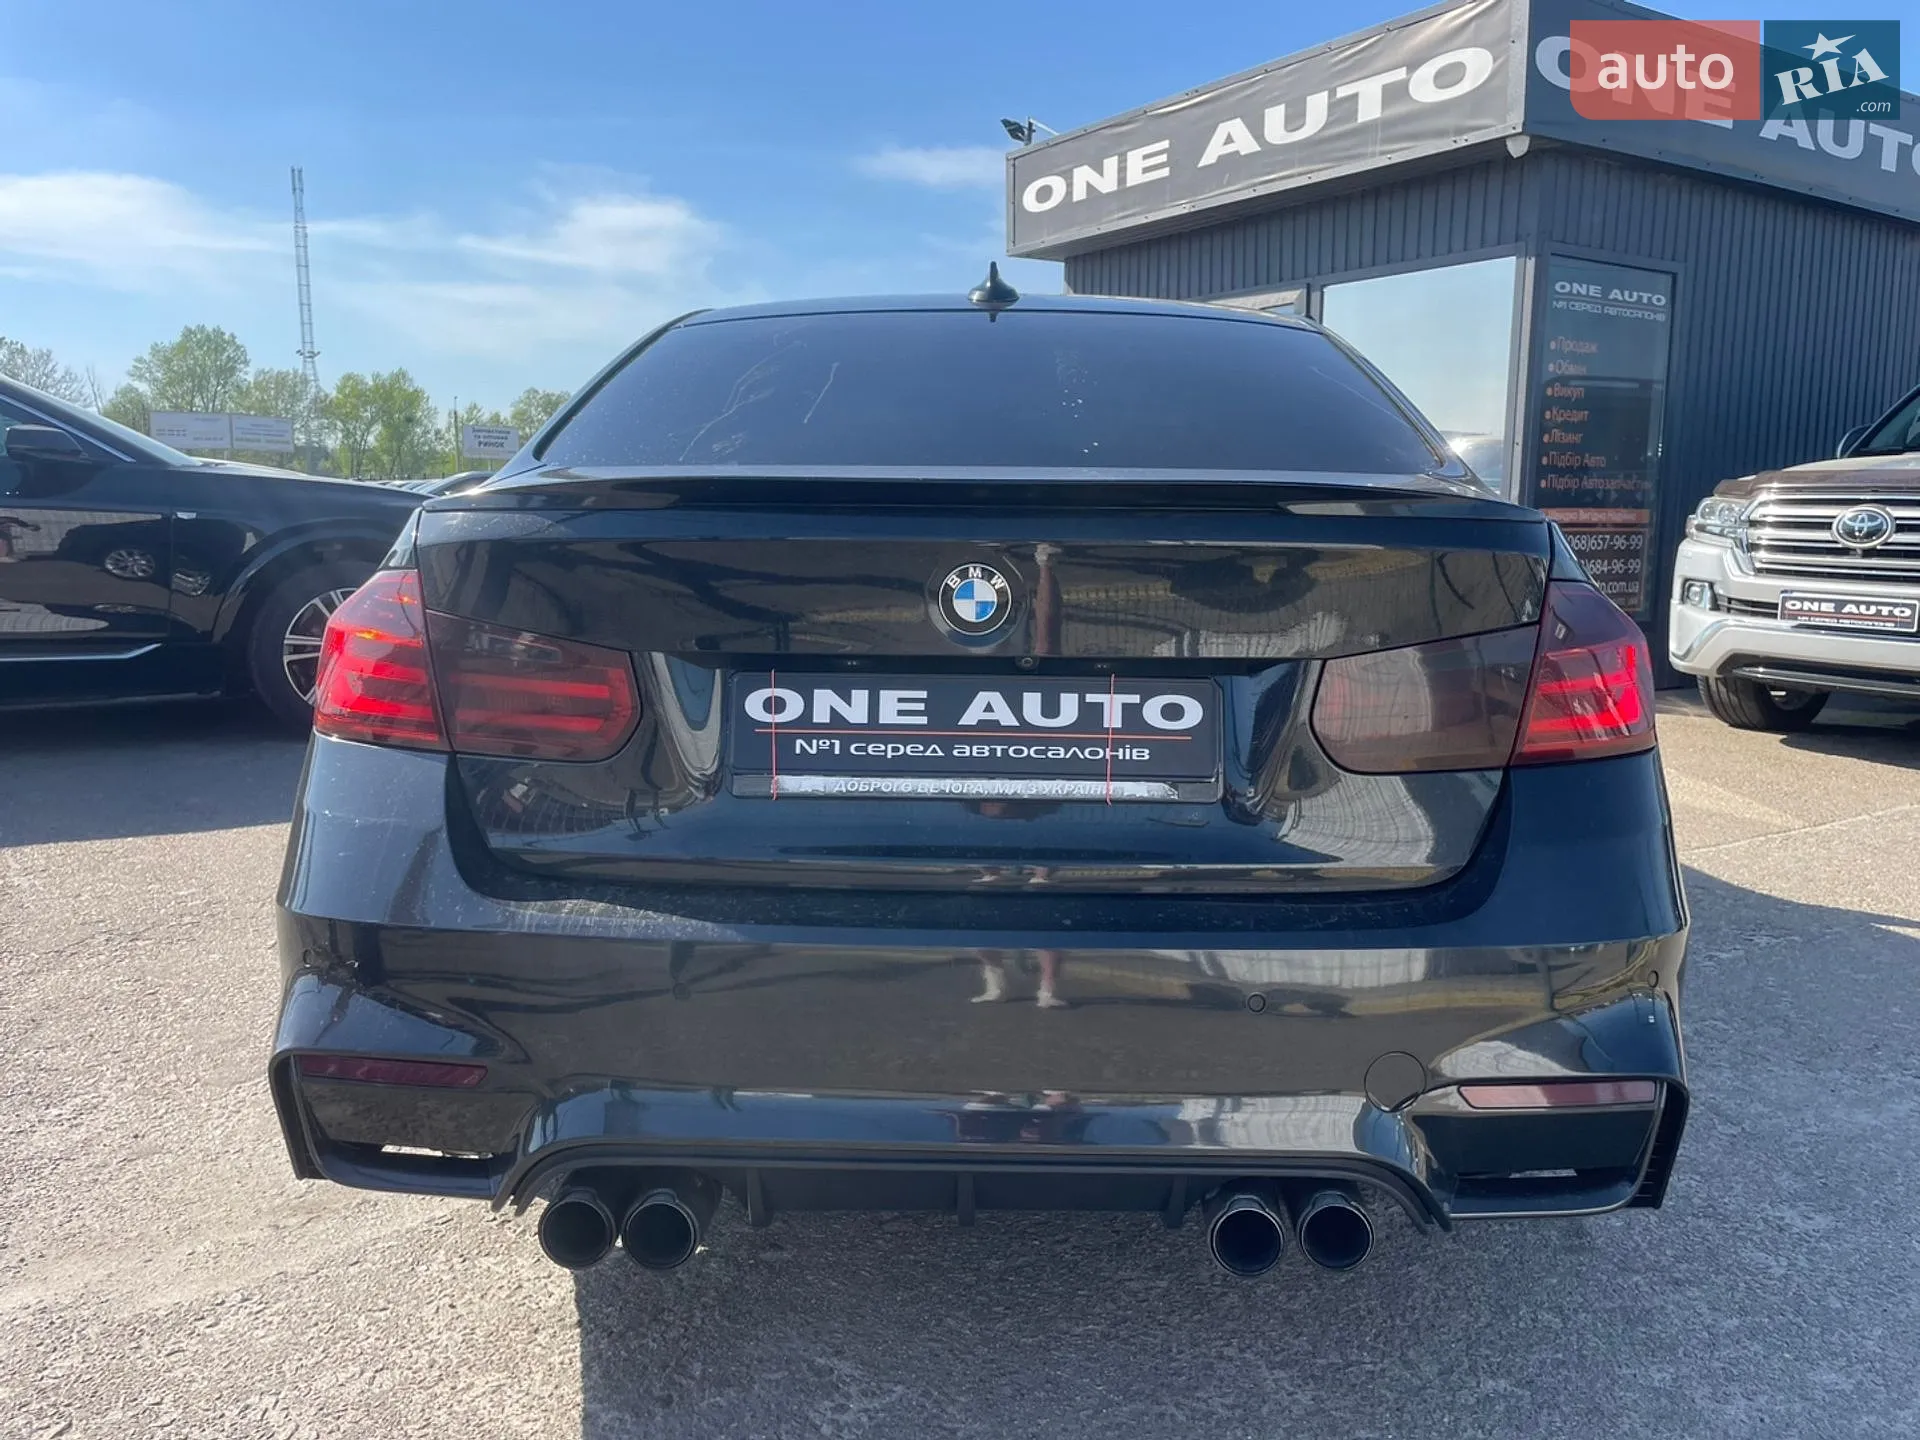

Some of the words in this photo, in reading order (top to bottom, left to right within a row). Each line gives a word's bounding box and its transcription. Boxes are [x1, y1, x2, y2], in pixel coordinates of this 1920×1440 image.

[1535, 36, 1736, 129] ONE
[1022, 140, 1170, 213] ONE
[1197, 47, 1494, 168] AUTO
[1554, 281, 1602, 298] ONE
[1608, 289, 1666, 306] AUTO
[1553, 382, 1585, 401] Викуп
[1552, 405, 1590, 424] Кредит
[1549, 428, 1583, 443] Лізинг
[1549, 452, 1581, 469] Підбір
[1583, 454, 1606, 468] Авто
[1547, 474, 1580, 491] Підбір
[946, 566, 1006, 590] BMW
[1785, 600, 1836, 612] ONE
[1841, 604, 1912, 617] AUTO
[744, 688, 928, 725] ONE
[957, 691, 1204, 731] AUTO
[795, 738, 840, 755] №1
[850, 742, 945, 759] серед
[952, 744, 1151, 760] автосалонів
[834, 780, 912, 794] ДОБРОГО
[995, 782, 1021, 795] МИ
